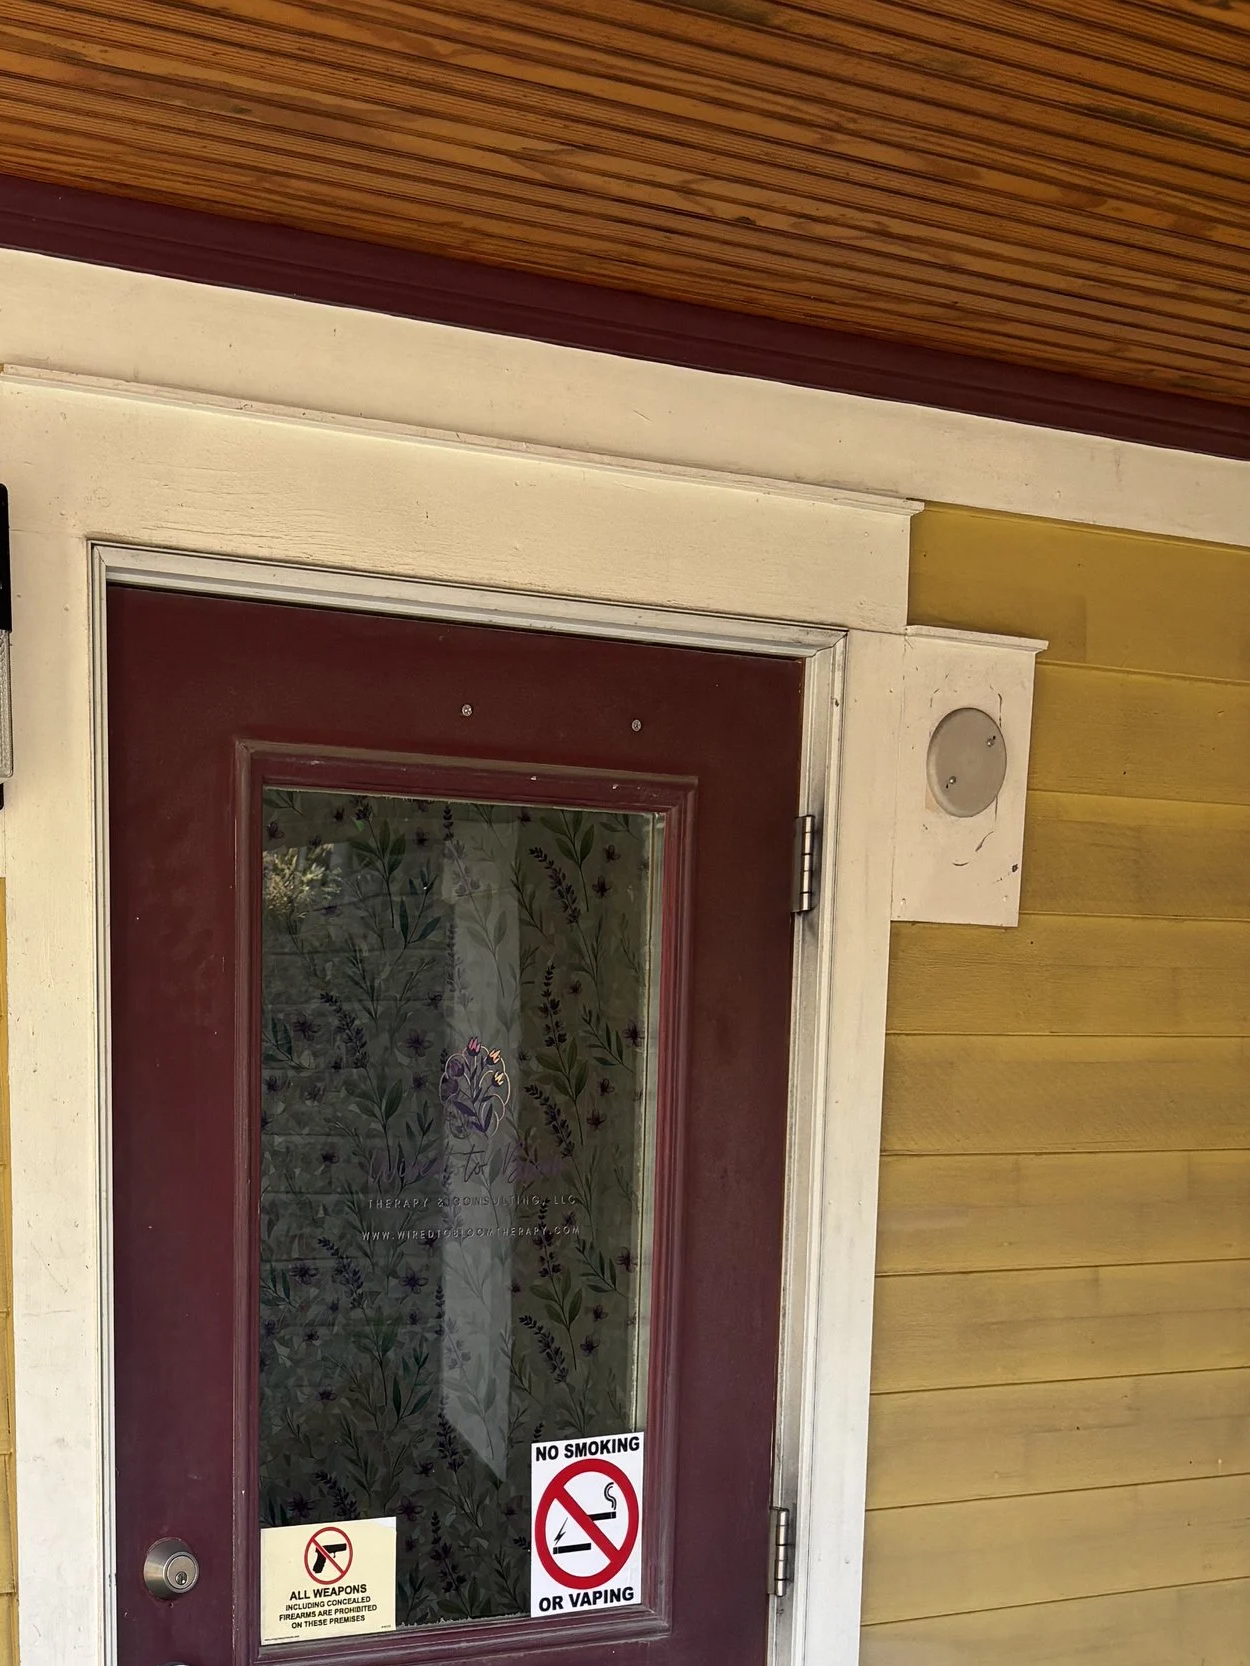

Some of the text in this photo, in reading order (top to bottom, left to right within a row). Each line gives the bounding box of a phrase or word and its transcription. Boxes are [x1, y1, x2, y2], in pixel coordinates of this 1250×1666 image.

[462, 1143, 488, 1183] to
[368, 1198, 429, 1209] THERAPY
[554, 1193, 577, 1205] LLC
[535, 1436, 641, 1462] NO SMOKING
[289, 1583, 367, 1601] ALL WEAPONS
[538, 1586, 635, 1612] OR VAPING
[285, 1595, 371, 1611] INCLUDING CONCEALED
[278, 1604, 378, 1622] FIREARMS ARE PROHIBITED
[291, 1614, 366, 1629] ON THESE PREMISES
